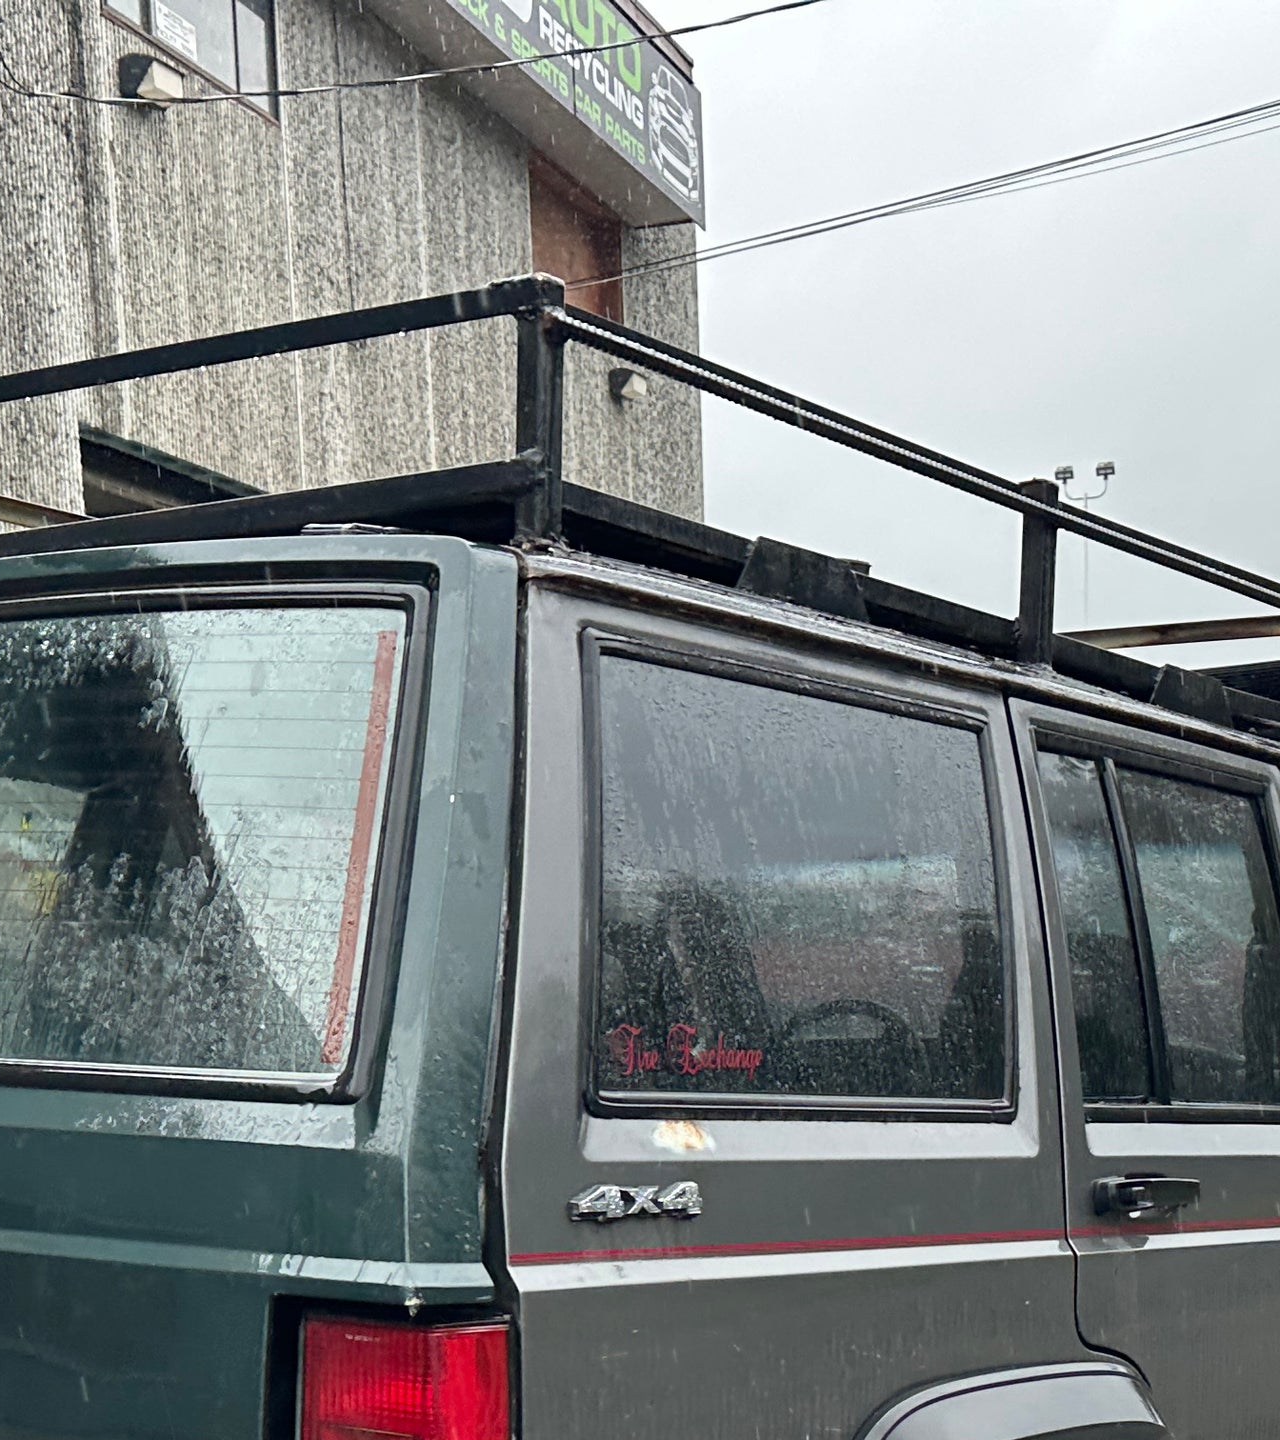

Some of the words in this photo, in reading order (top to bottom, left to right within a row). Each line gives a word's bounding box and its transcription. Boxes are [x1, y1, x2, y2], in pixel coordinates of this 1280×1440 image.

[494, 13, 507, 41] &
[511, 28, 569, 97] SPORTS
[575, 84, 602, 126] CAR
[605, 112, 646, 165] PARTS
[539, 5, 644, 130] RECYCLING
